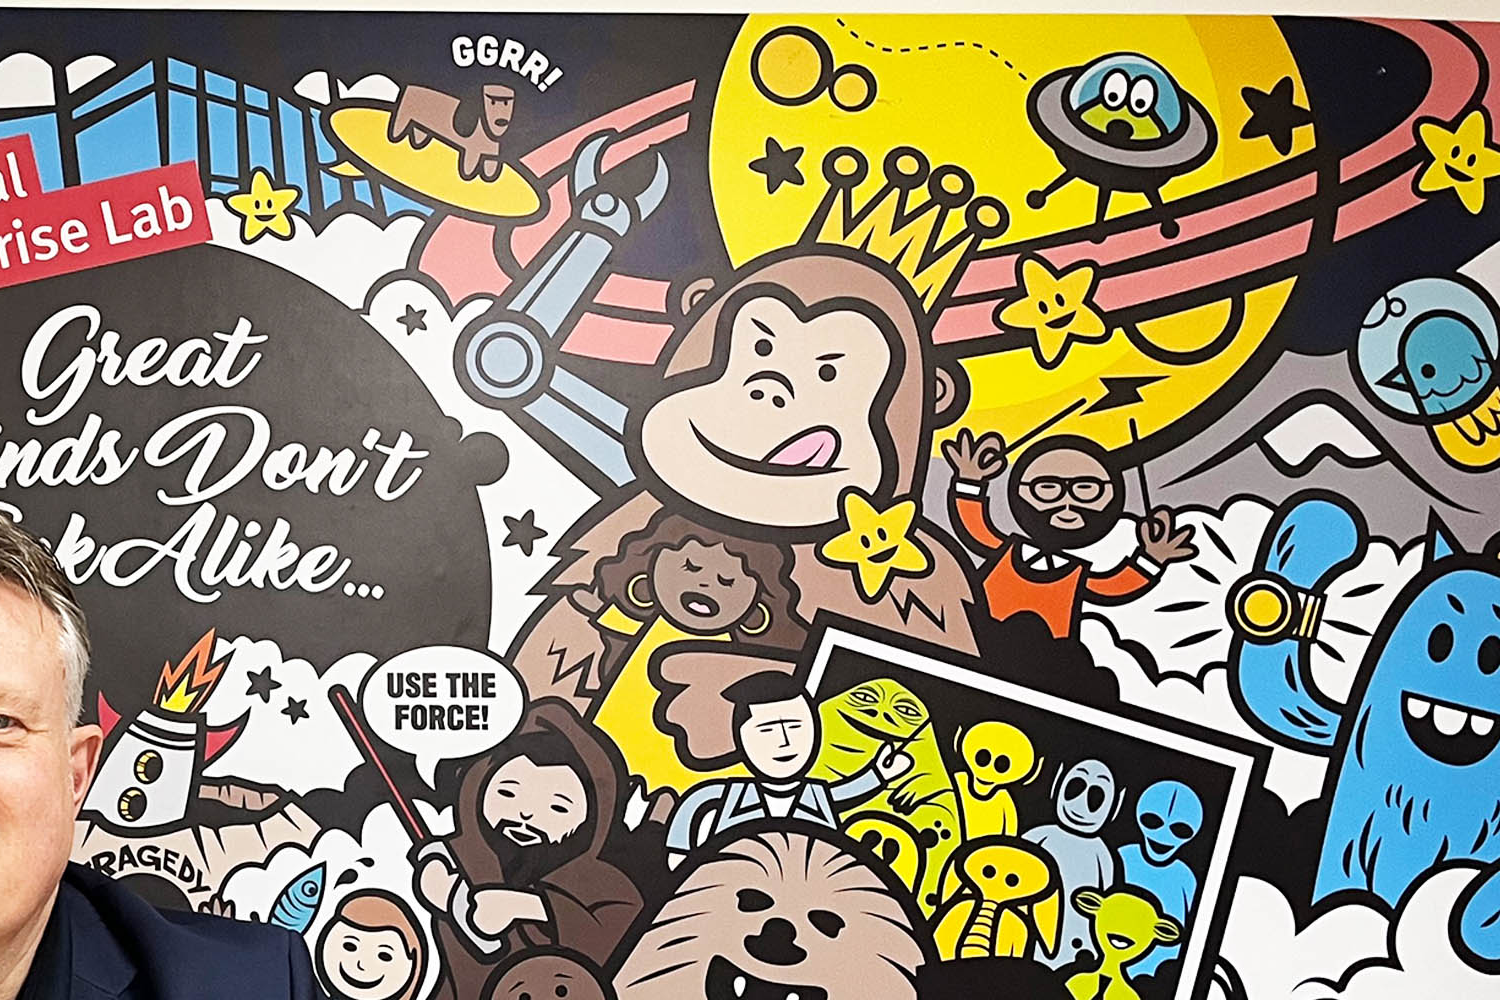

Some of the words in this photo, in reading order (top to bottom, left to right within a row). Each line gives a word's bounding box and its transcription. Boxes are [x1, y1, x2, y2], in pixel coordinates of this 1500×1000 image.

[451, 34, 564, 93] GGRR!
[100, 186, 193, 246] Lab
[21, 304, 268, 426] Great
[143, 404, 430, 506] Don't
[100, 501, 384, 603] Alike...
[387, 672, 437, 698] USE
[445, 672, 496, 698] THE
[395, 704, 489, 730] FORCE!
[84, 844, 211, 893] RAGEDY
